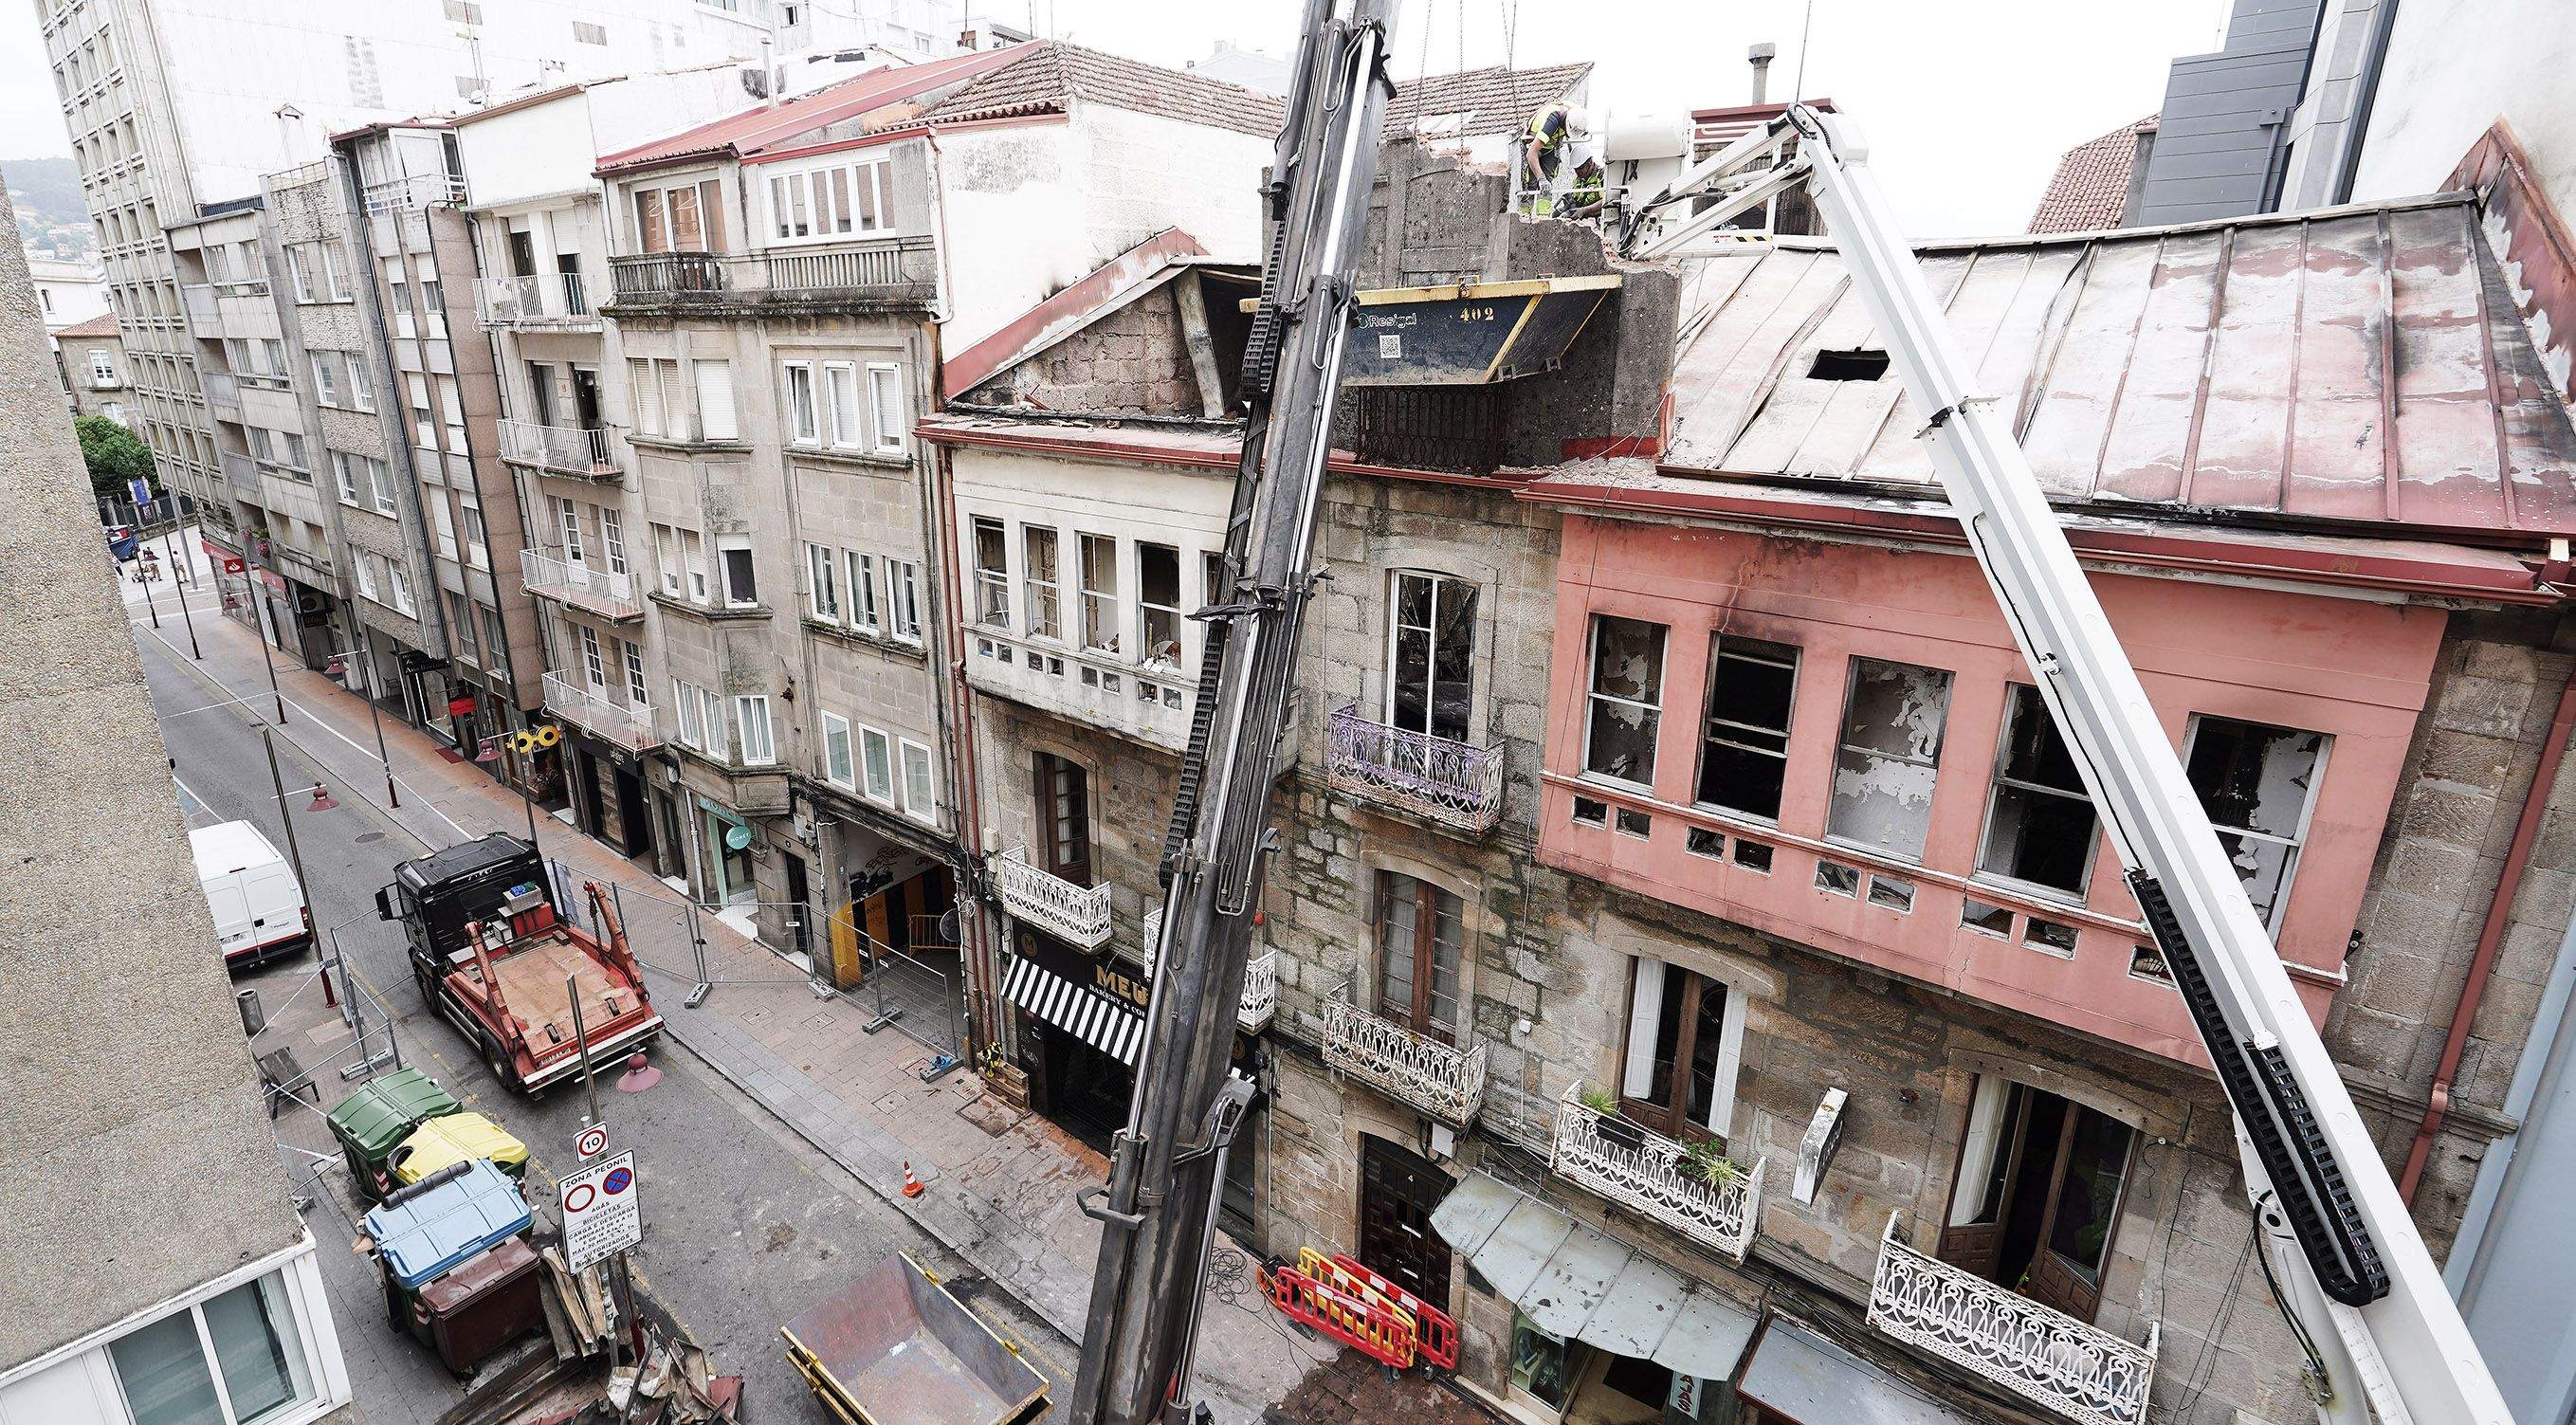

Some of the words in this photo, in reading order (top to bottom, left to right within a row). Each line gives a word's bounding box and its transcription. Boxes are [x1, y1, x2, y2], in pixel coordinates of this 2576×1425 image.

[1369, 313, 1416, 328] Resigal
[1460, 307, 1495, 321] 402
[1088, 984, 1121, 1005] BAKERY
[1131, 1007, 1145, 1017] COF
[585, 1137, 599, 1149] 10
[565, 1172, 593, 1188] ZONA
[594, 1158, 628, 1174] PEONIL
[569, 1226, 593, 1239] CARGA
[599, 1206, 635, 1225] DESCARGA
[583, 1204, 620, 1225] BICICLETAS
[583, 1234, 630, 1259] AUTORIZADOS
[1678, 1375, 1695, 1412] AJAS
